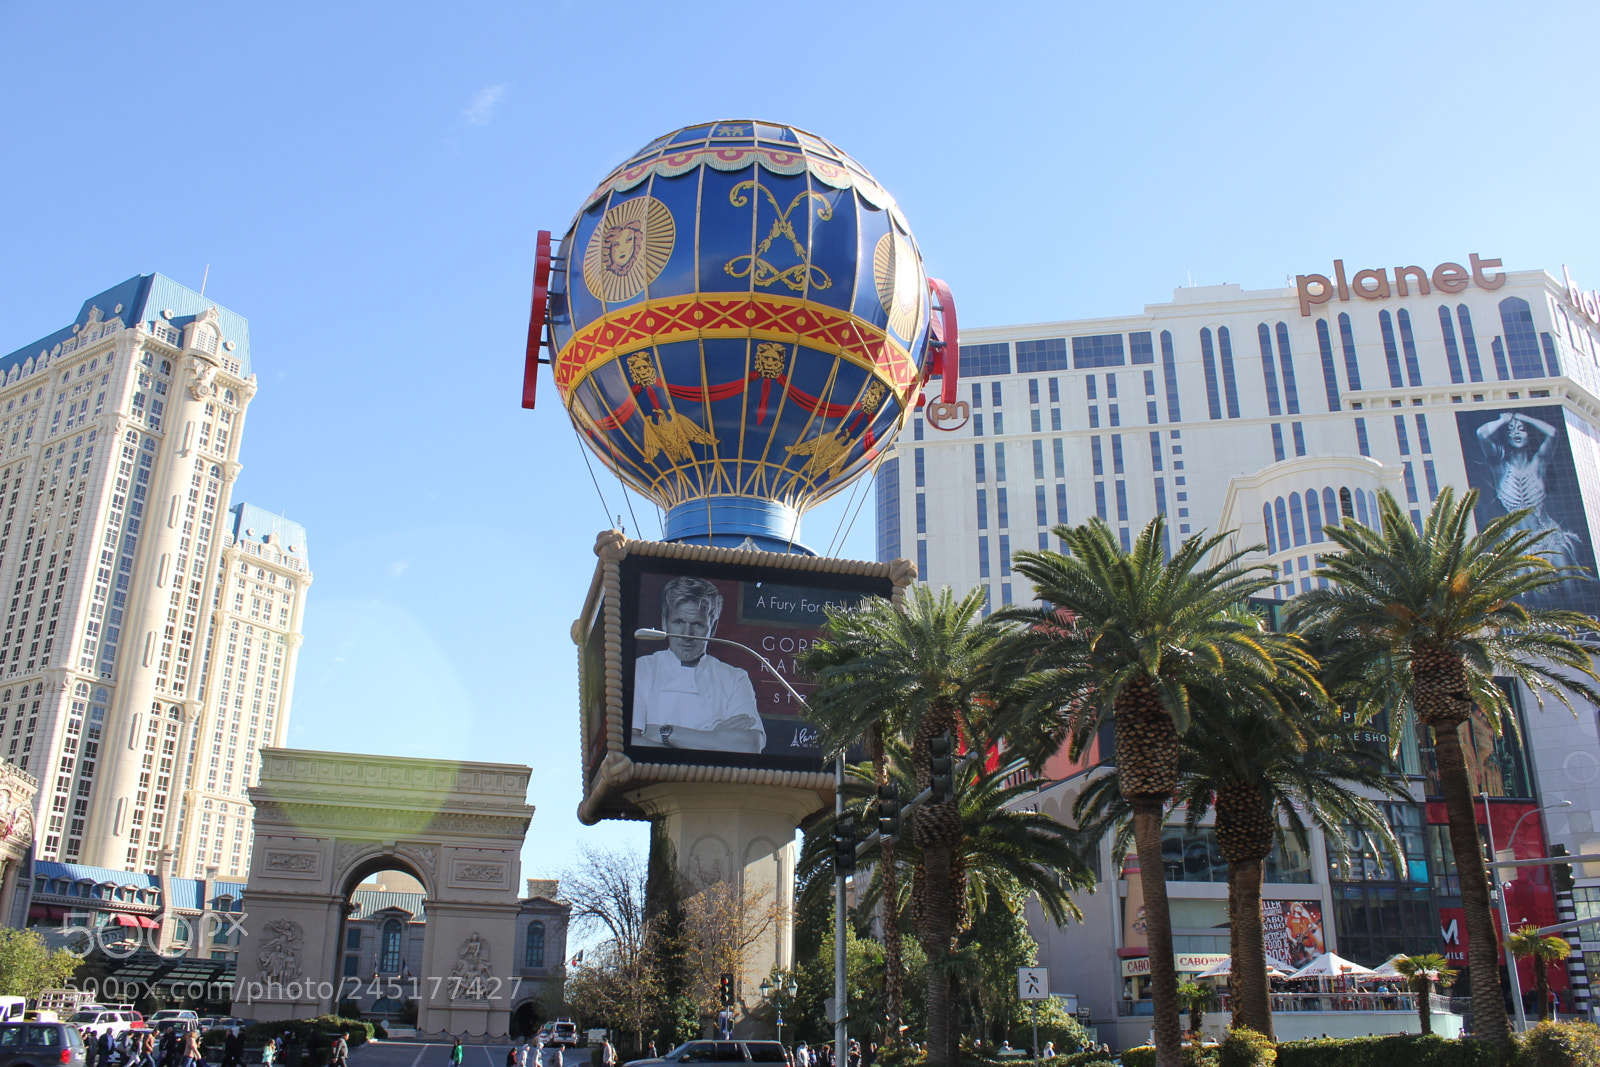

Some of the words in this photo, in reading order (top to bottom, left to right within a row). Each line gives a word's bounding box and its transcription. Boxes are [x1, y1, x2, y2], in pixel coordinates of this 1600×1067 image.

[1296, 252, 1506, 317] planet
[1562, 264, 1600, 324] ho
[756, 596, 766, 608] A
[770, 596, 796, 613] Fury
[801, 599, 820, 612] For
[1127, 959, 1150, 973] CABO
[1179, 957, 1209, 967] CABO
